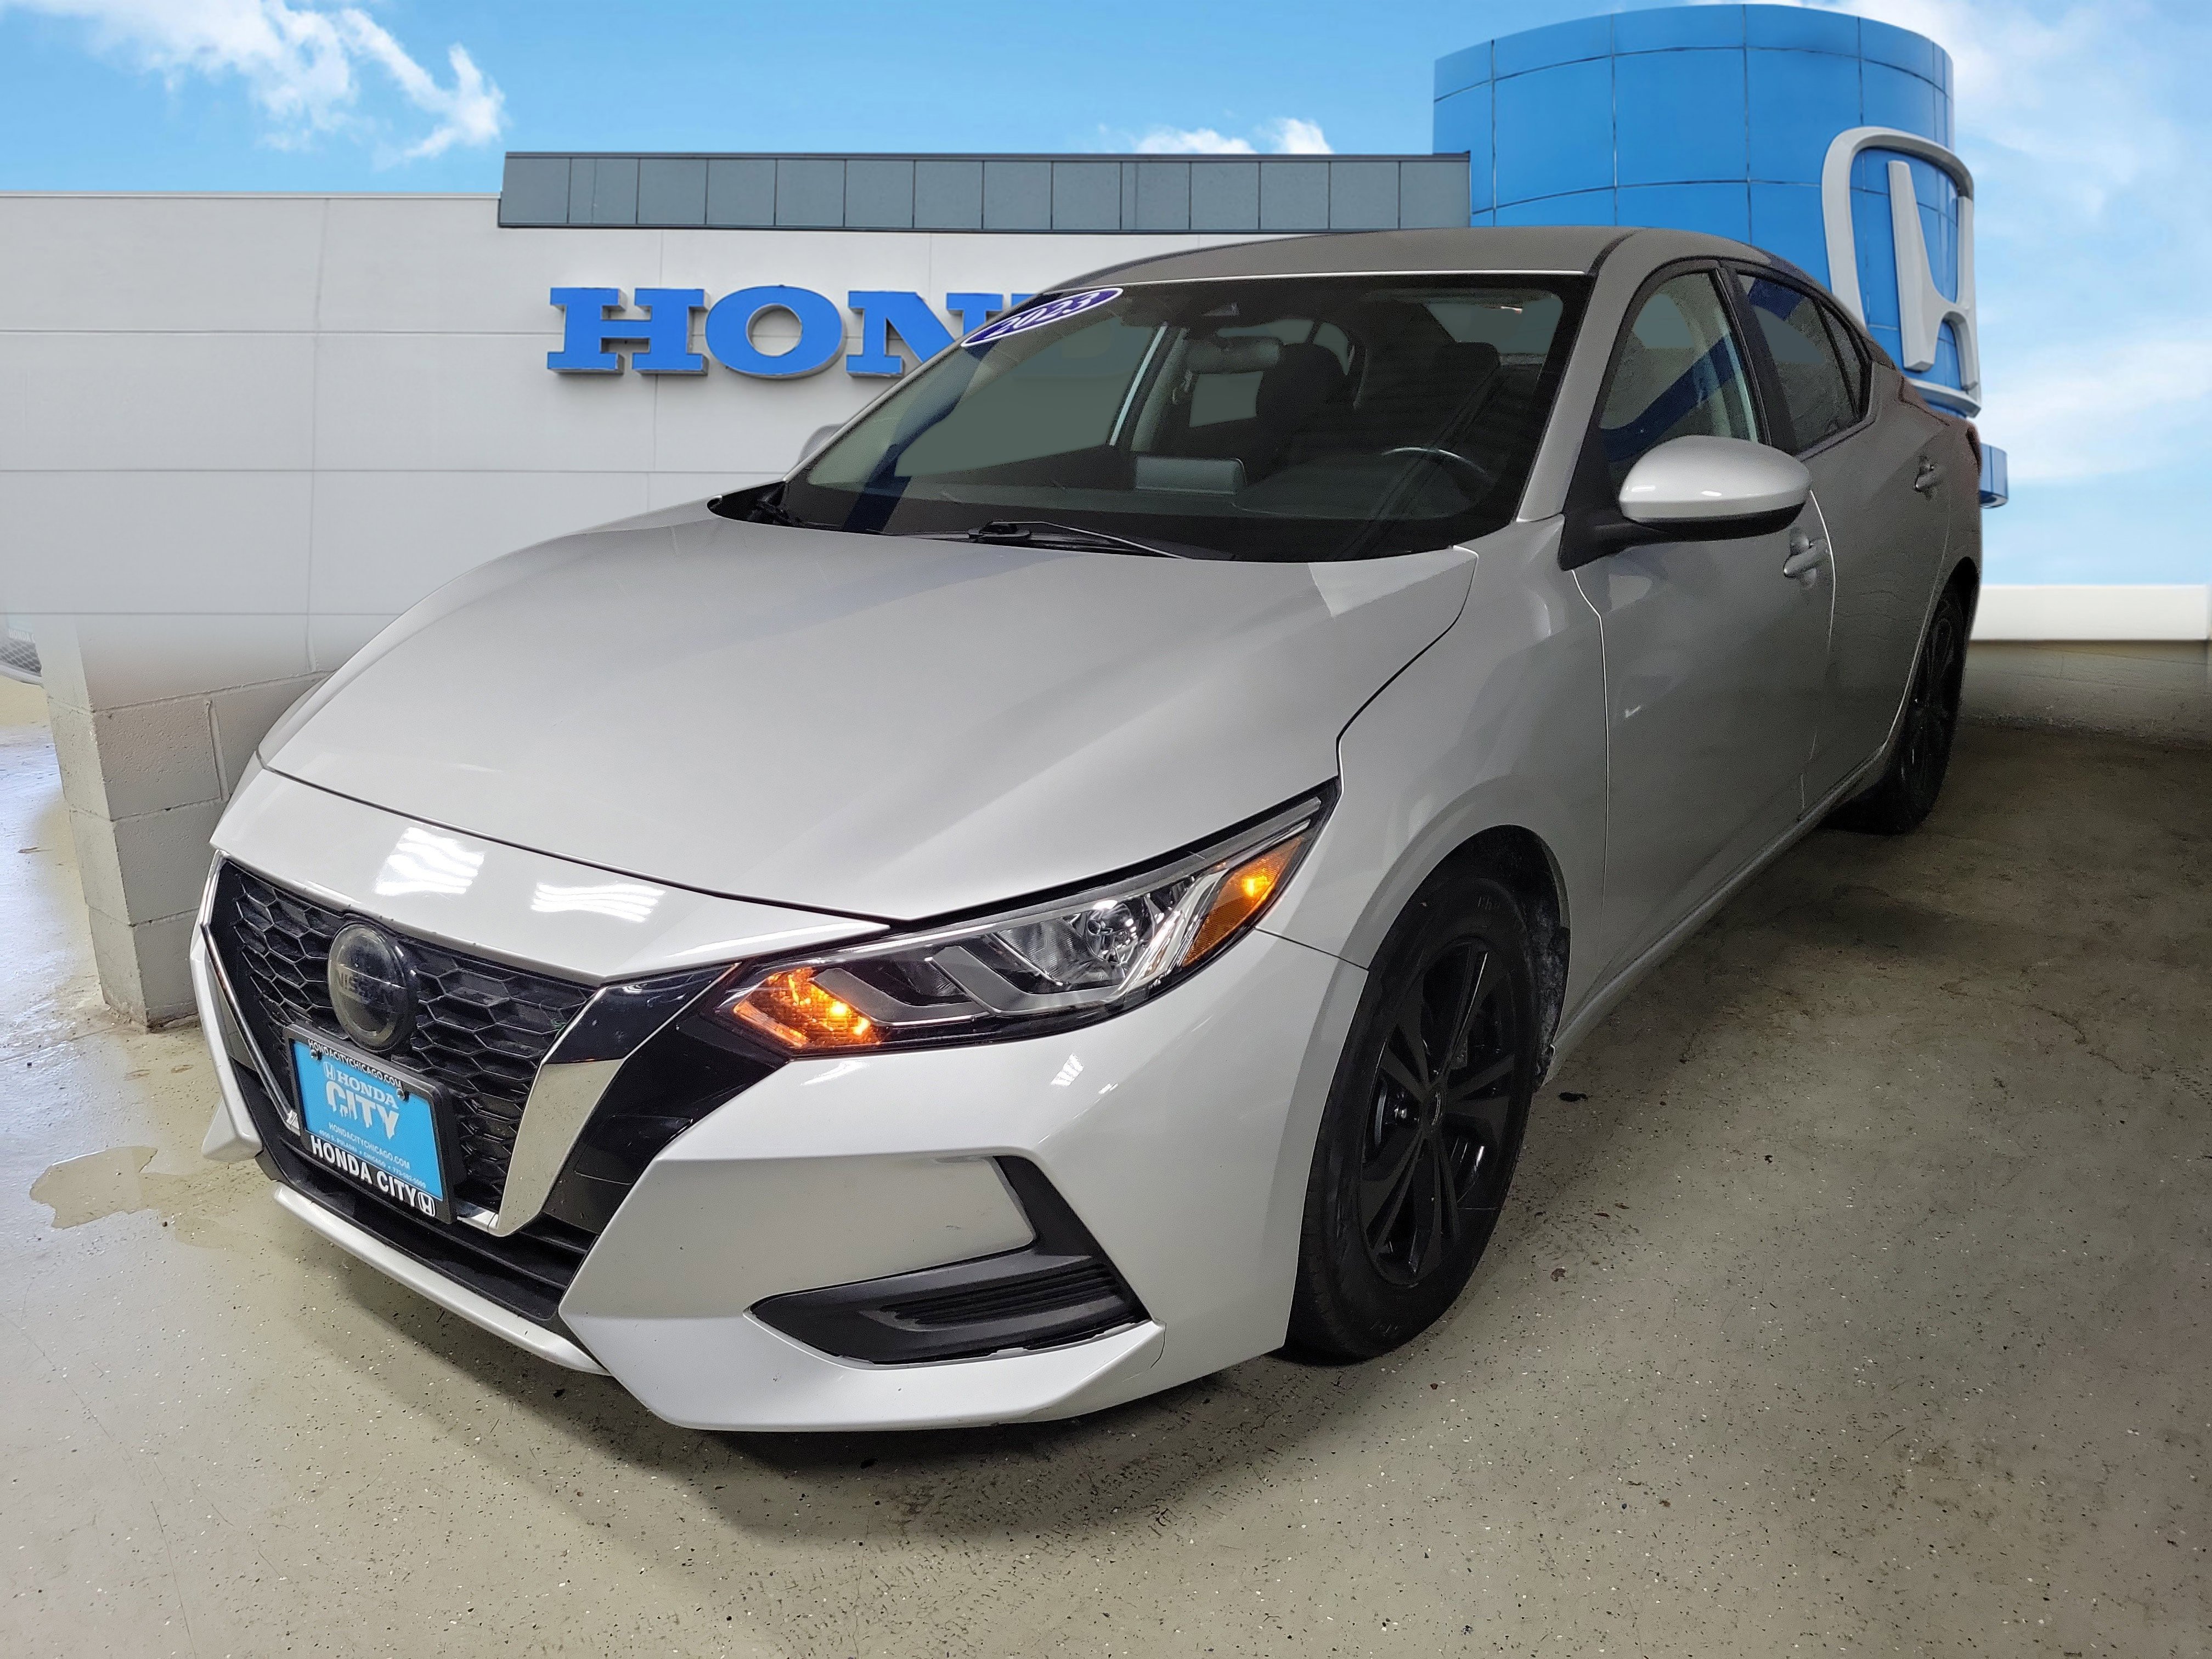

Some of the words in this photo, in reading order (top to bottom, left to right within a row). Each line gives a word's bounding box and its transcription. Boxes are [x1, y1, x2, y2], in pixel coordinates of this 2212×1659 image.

[547, 285, 1039, 379] HON
[984, 291, 1100, 340] 2023
[8, 628, 31, 642] HONDA
[308, 1039, 404, 1090] HONDACITYCHICAGO.COM
[326, 1080, 399, 1139] CITY
[336, 1070, 399, 1110] HONDA
[310, 1135, 373, 1185] HONDA
[376, 1170, 417, 1207] CITY
[329, 1121, 410, 1171] HONDACITYCHICAGO.COM
